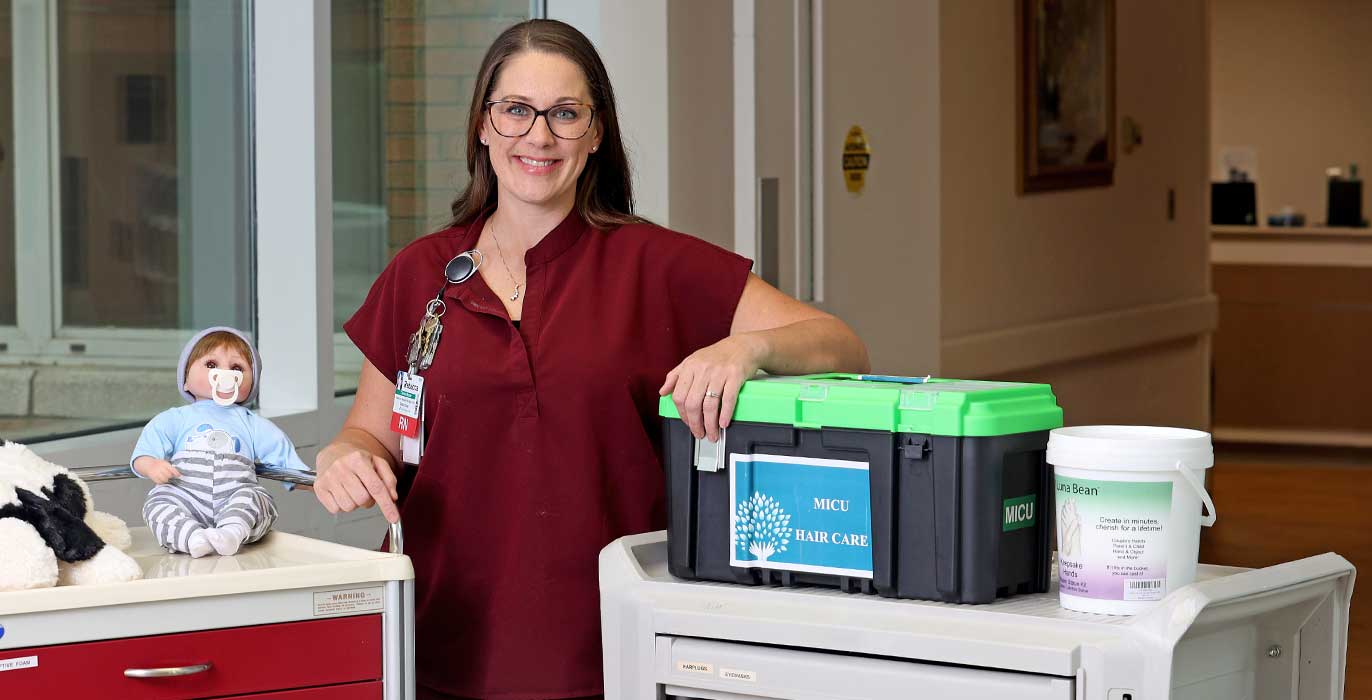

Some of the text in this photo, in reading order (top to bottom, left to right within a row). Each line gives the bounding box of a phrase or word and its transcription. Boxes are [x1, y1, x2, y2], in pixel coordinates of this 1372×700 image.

[399, 416, 408, 430] RN
[813, 497, 849, 512] MICU
[1005, 502, 1034, 525] MICU
[1099, 516, 1122, 524] Create
[795, 529, 869, 547] HAIR CARE
[332, 591, 366, 601] WARNING
[682, 664, 708, 672] EARPLUGS
